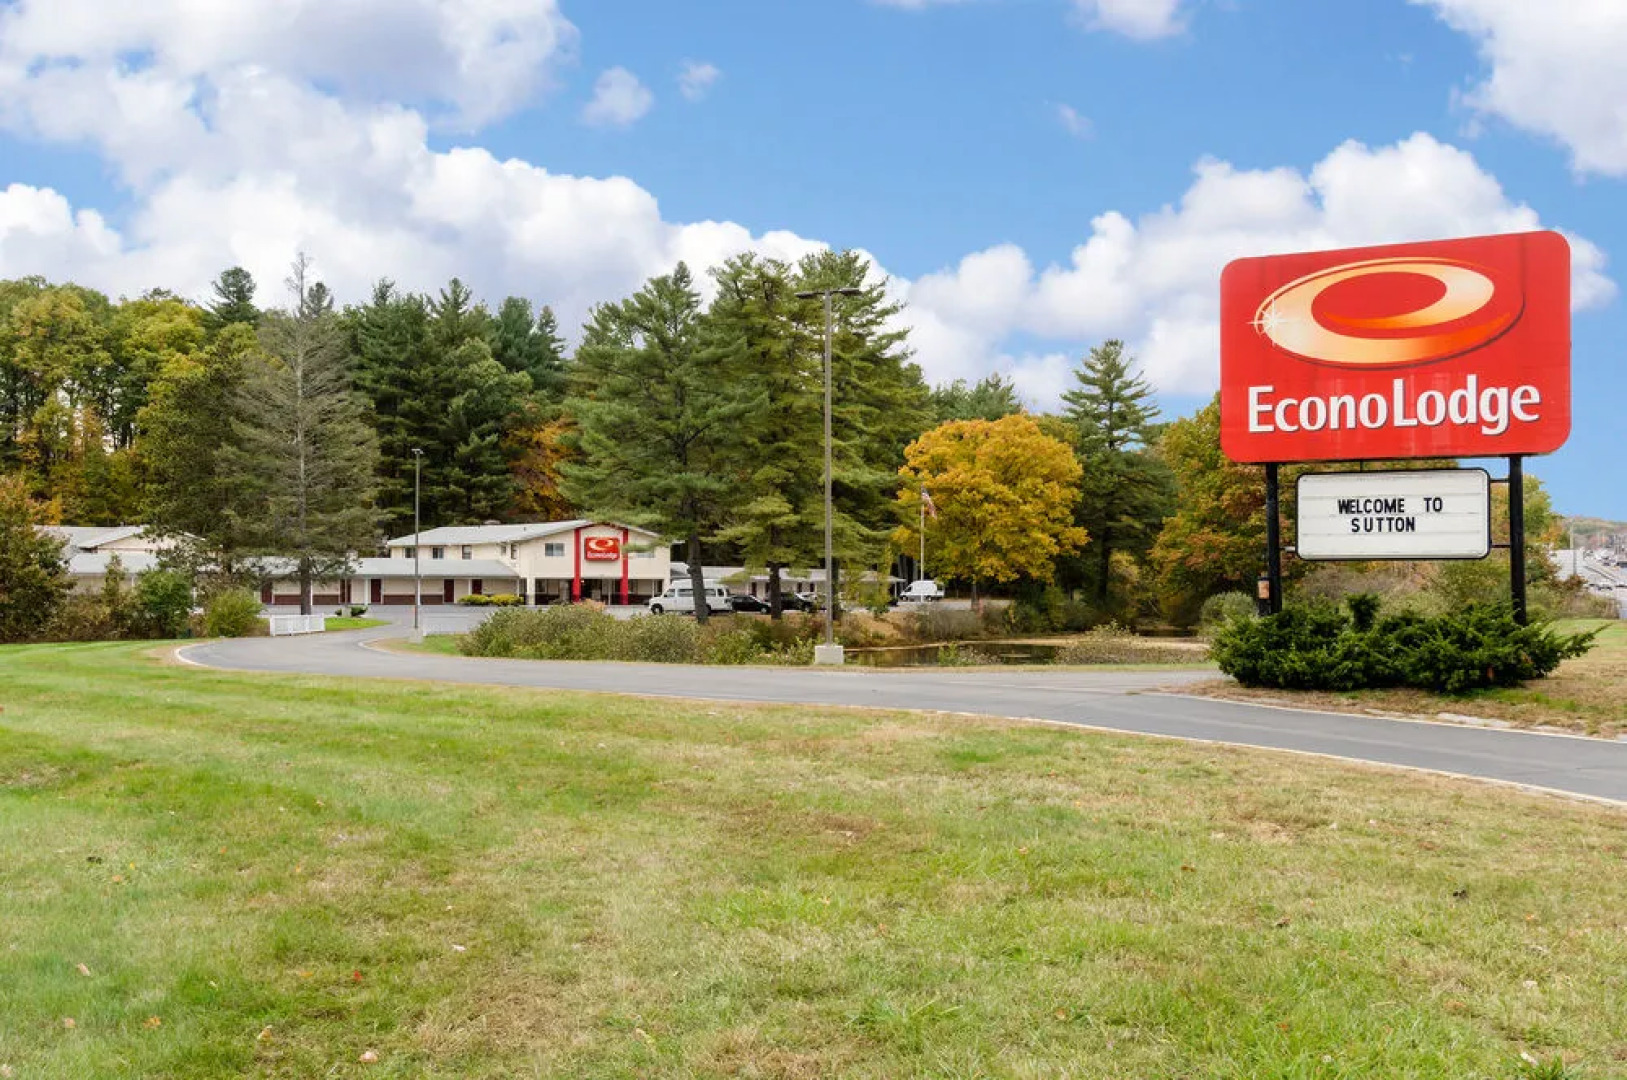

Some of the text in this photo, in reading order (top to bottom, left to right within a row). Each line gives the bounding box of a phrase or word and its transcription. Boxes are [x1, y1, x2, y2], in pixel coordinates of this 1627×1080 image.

[1337, 497, 1443, 514] WELCOME TO
[1351, 517, 1415, 533] SUTTON
